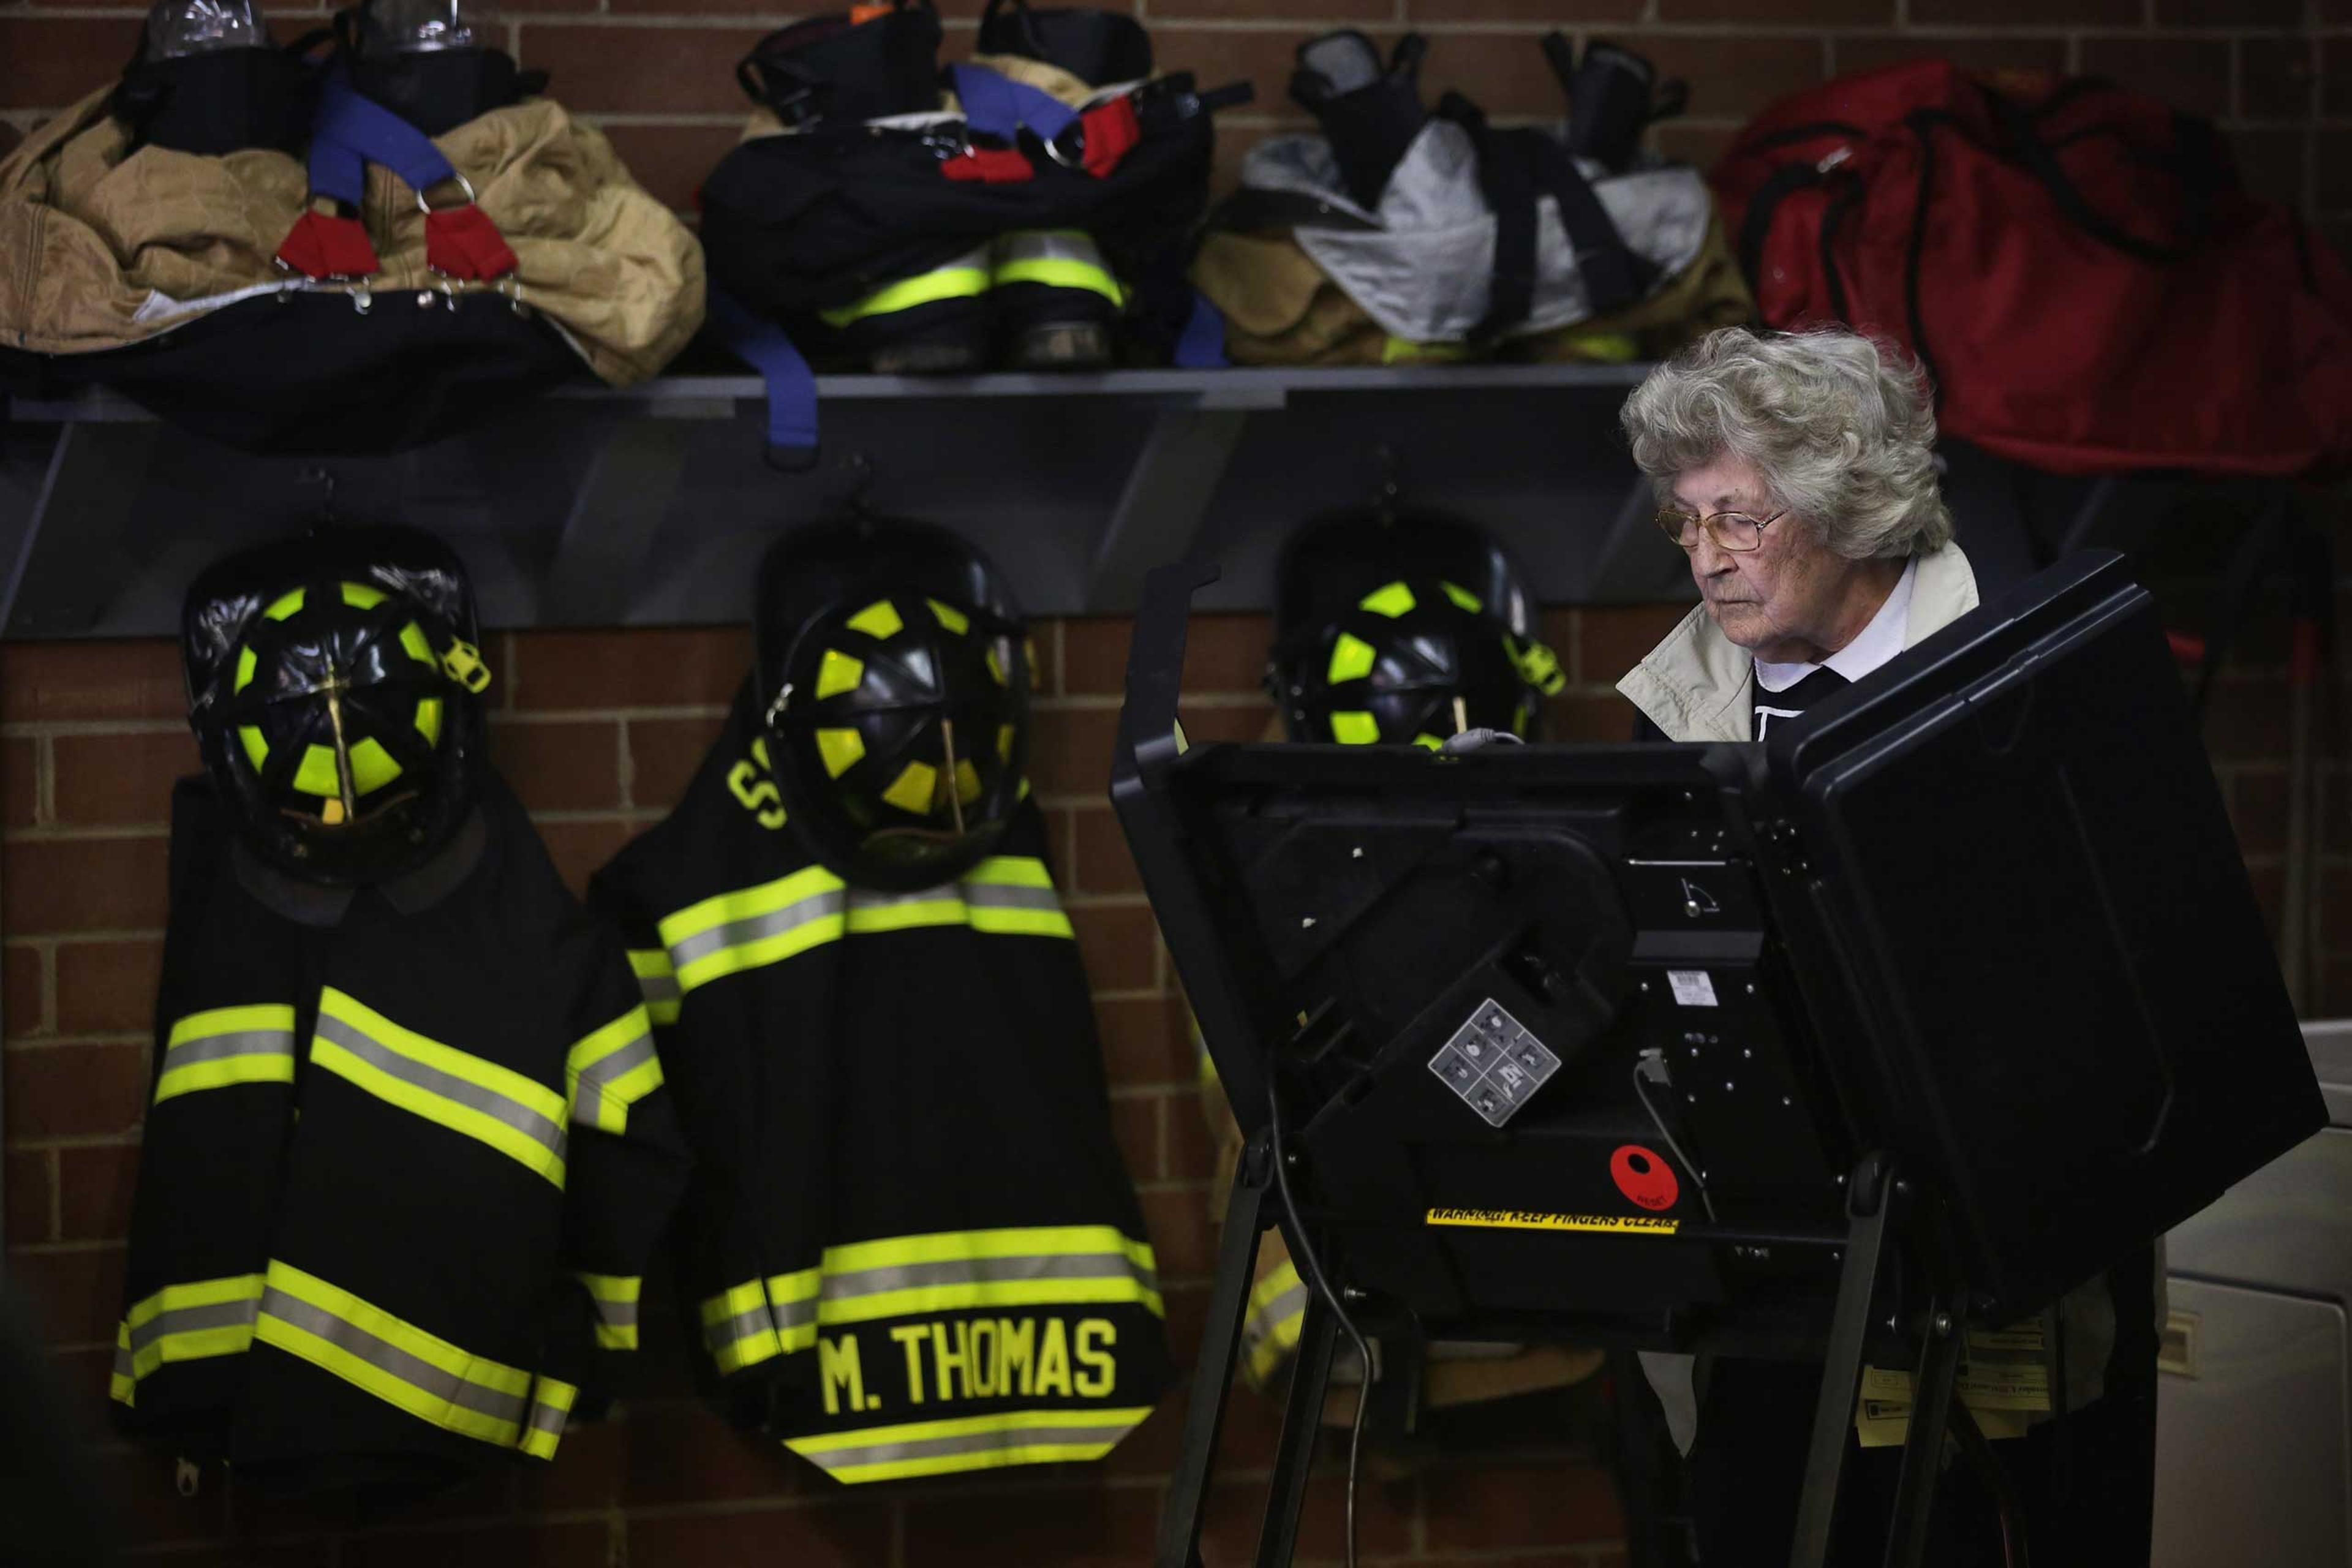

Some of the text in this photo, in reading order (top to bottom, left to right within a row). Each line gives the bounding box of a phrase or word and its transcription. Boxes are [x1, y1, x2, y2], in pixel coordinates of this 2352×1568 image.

[1509, 1212, 1550, 1224] KEEP
[1553, 1213, 1619, 1225] FINGERS
[818, 1316, 1117, 1415] M. THOMAS
